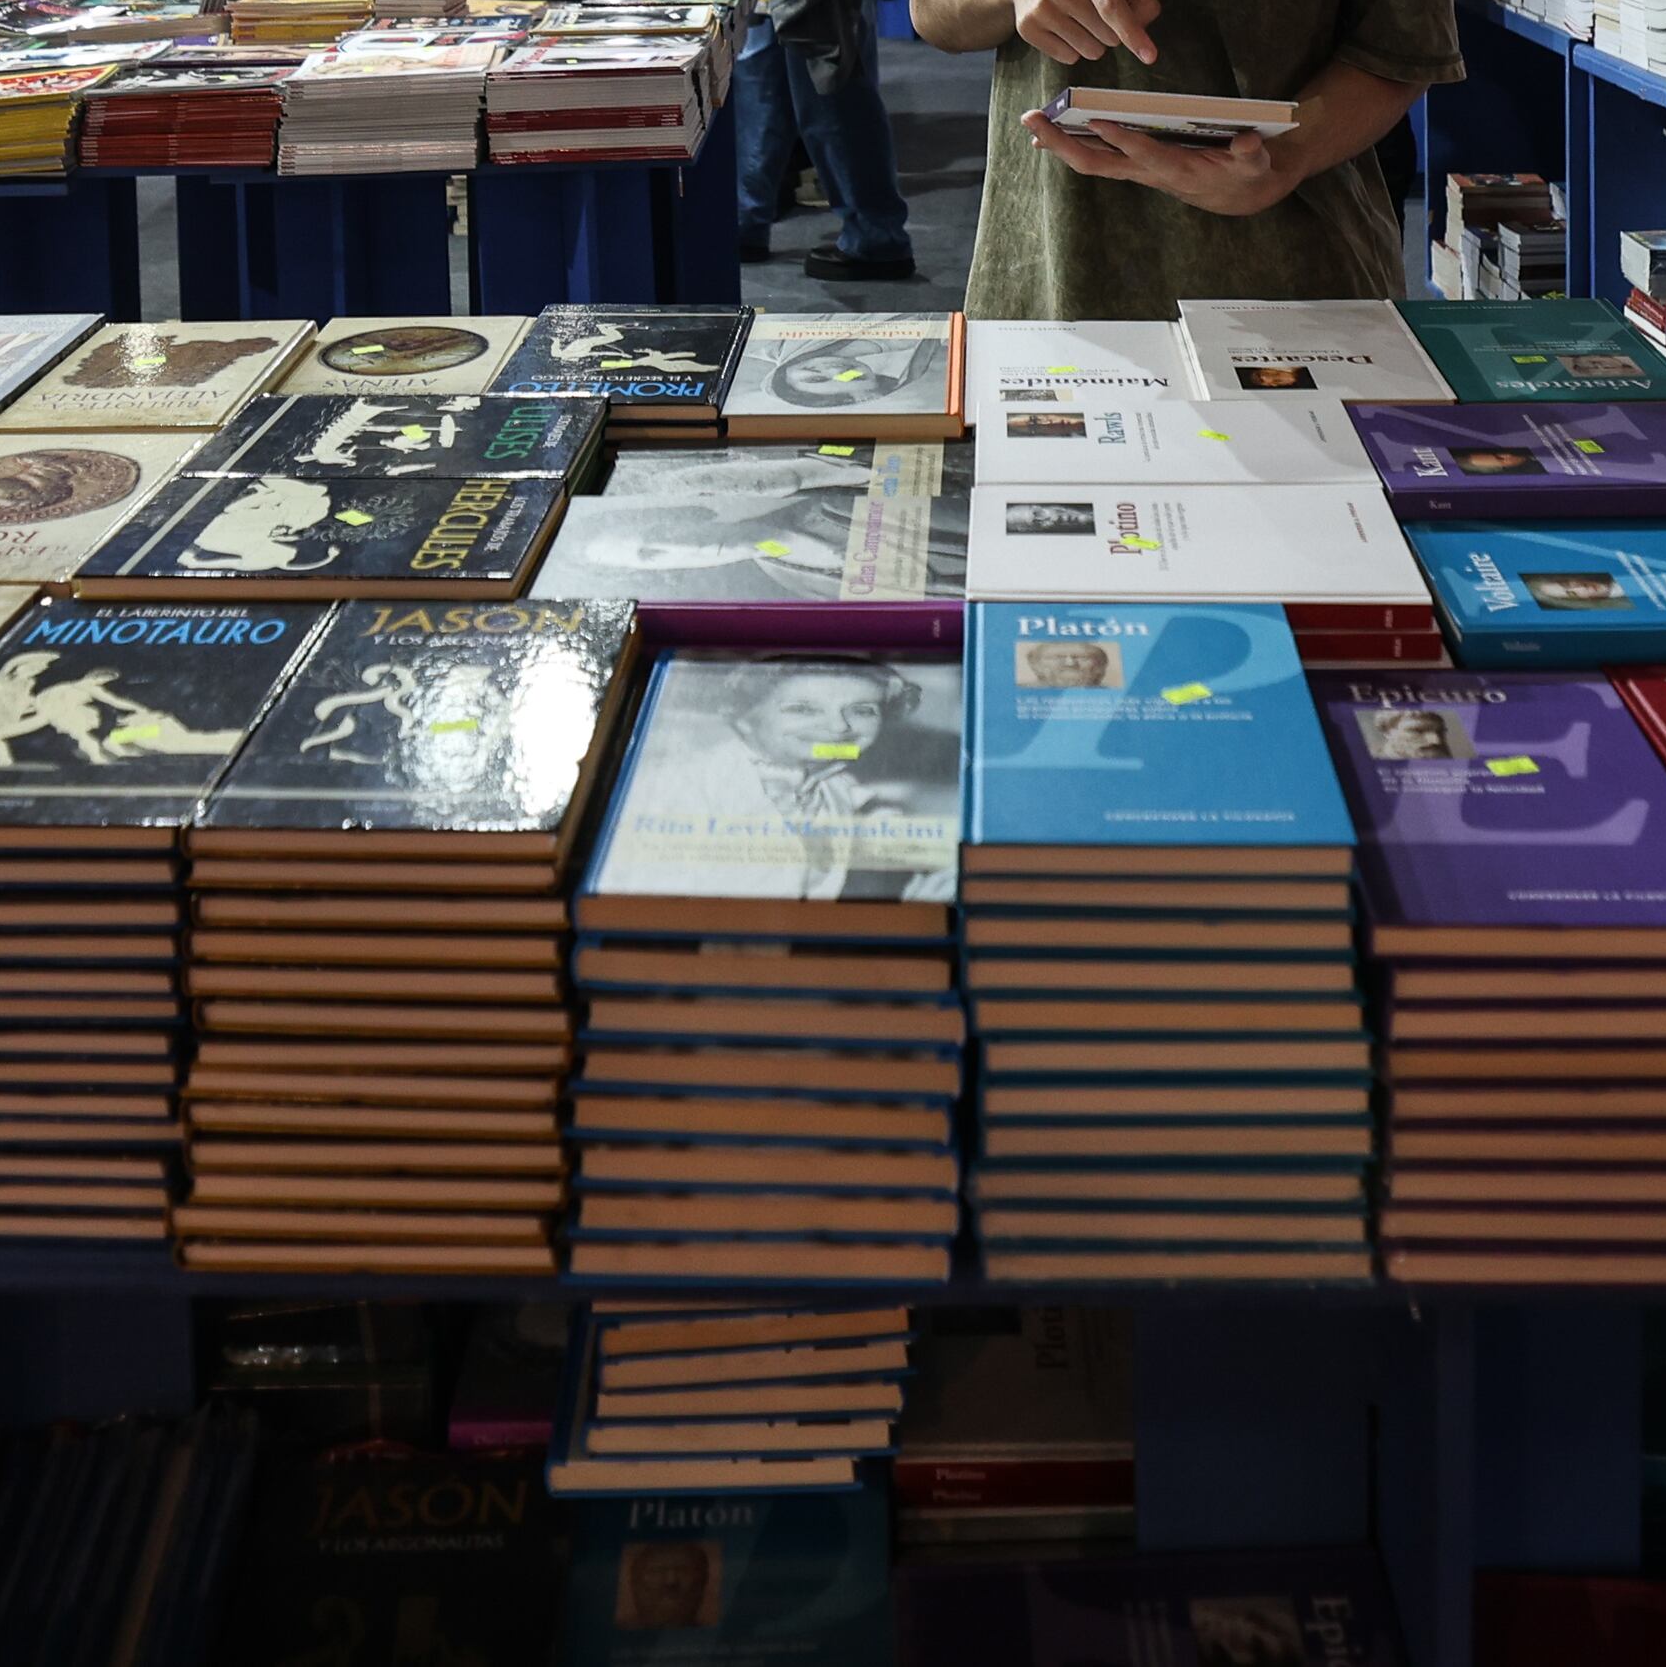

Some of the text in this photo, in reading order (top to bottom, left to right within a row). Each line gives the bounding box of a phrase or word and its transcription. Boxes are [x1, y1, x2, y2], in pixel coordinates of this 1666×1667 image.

[1231, 353, 1373, 366] Descartes
[999, 377, 1169, 389] Maimónides
[1496, 380, 1651, 393] Aristóteles
[483, 405, 557, 459] ULISES
[1094, 412, 1127, 445] Rawls
[1413, 447, 1449, 477] Kant
[409, 479, 513, 570] HÉRCULES
[1465, 551, 1520, 613] Voltaire
[119, 607, 209, 618] LABERINTO
[215, 607, 248, 618] DEL
[1017, 616, 1150, 638] Platón
[22, 617, 288, 649] MINOTAURO
[389, 634, 426, 646] LOS
[1350, 681, 1507, 710] Epicuro
[635, 817, 694, 834] Rita
[309, 1472, 530, 1535] JASÓN
[628, 1499, 759, 1530] Platón
[375, 1535, 506, 1552] ARGONAUTAS
